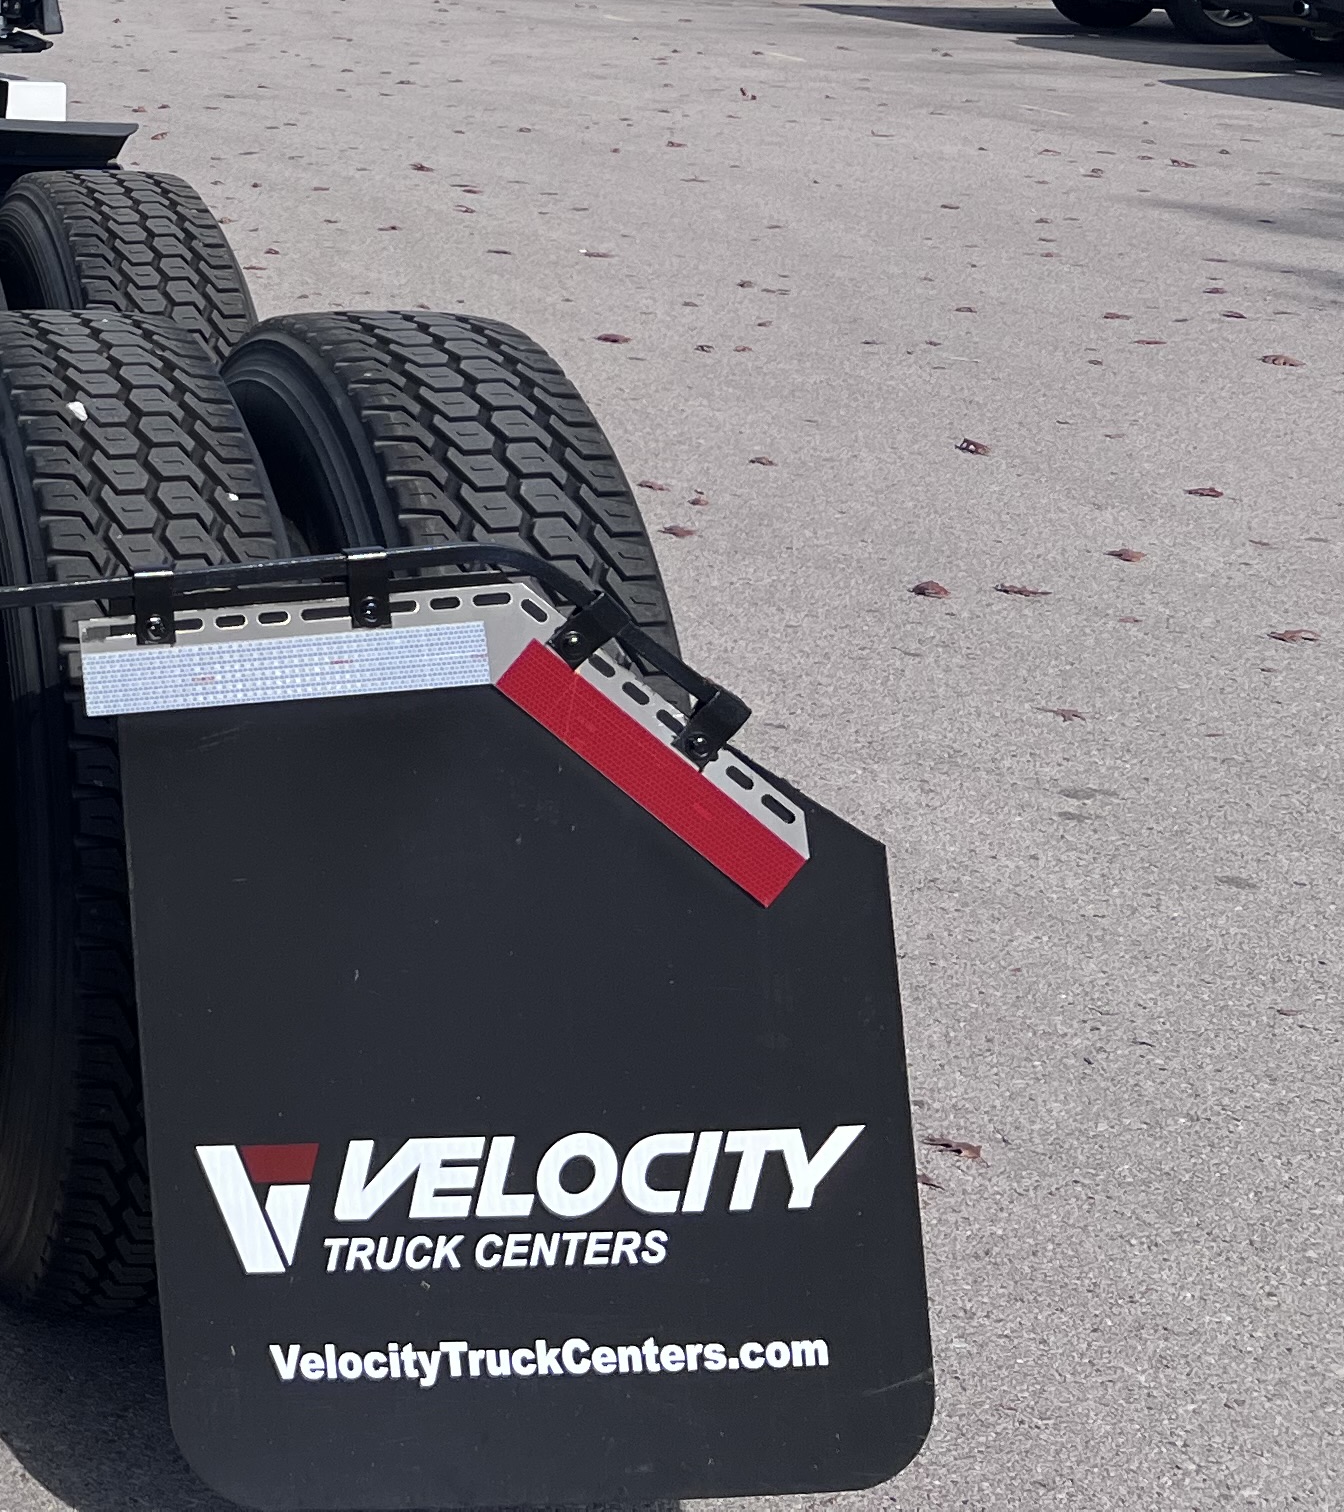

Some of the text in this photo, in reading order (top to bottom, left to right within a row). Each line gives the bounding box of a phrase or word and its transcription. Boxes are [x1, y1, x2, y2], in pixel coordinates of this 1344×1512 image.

[333, 1124, 866, 1221] VELOCITY
[323, 1229, 669, 1273] TRUCK CENTERS
[268, 1336, 830, 1388] VelocityTruckCenters.com
